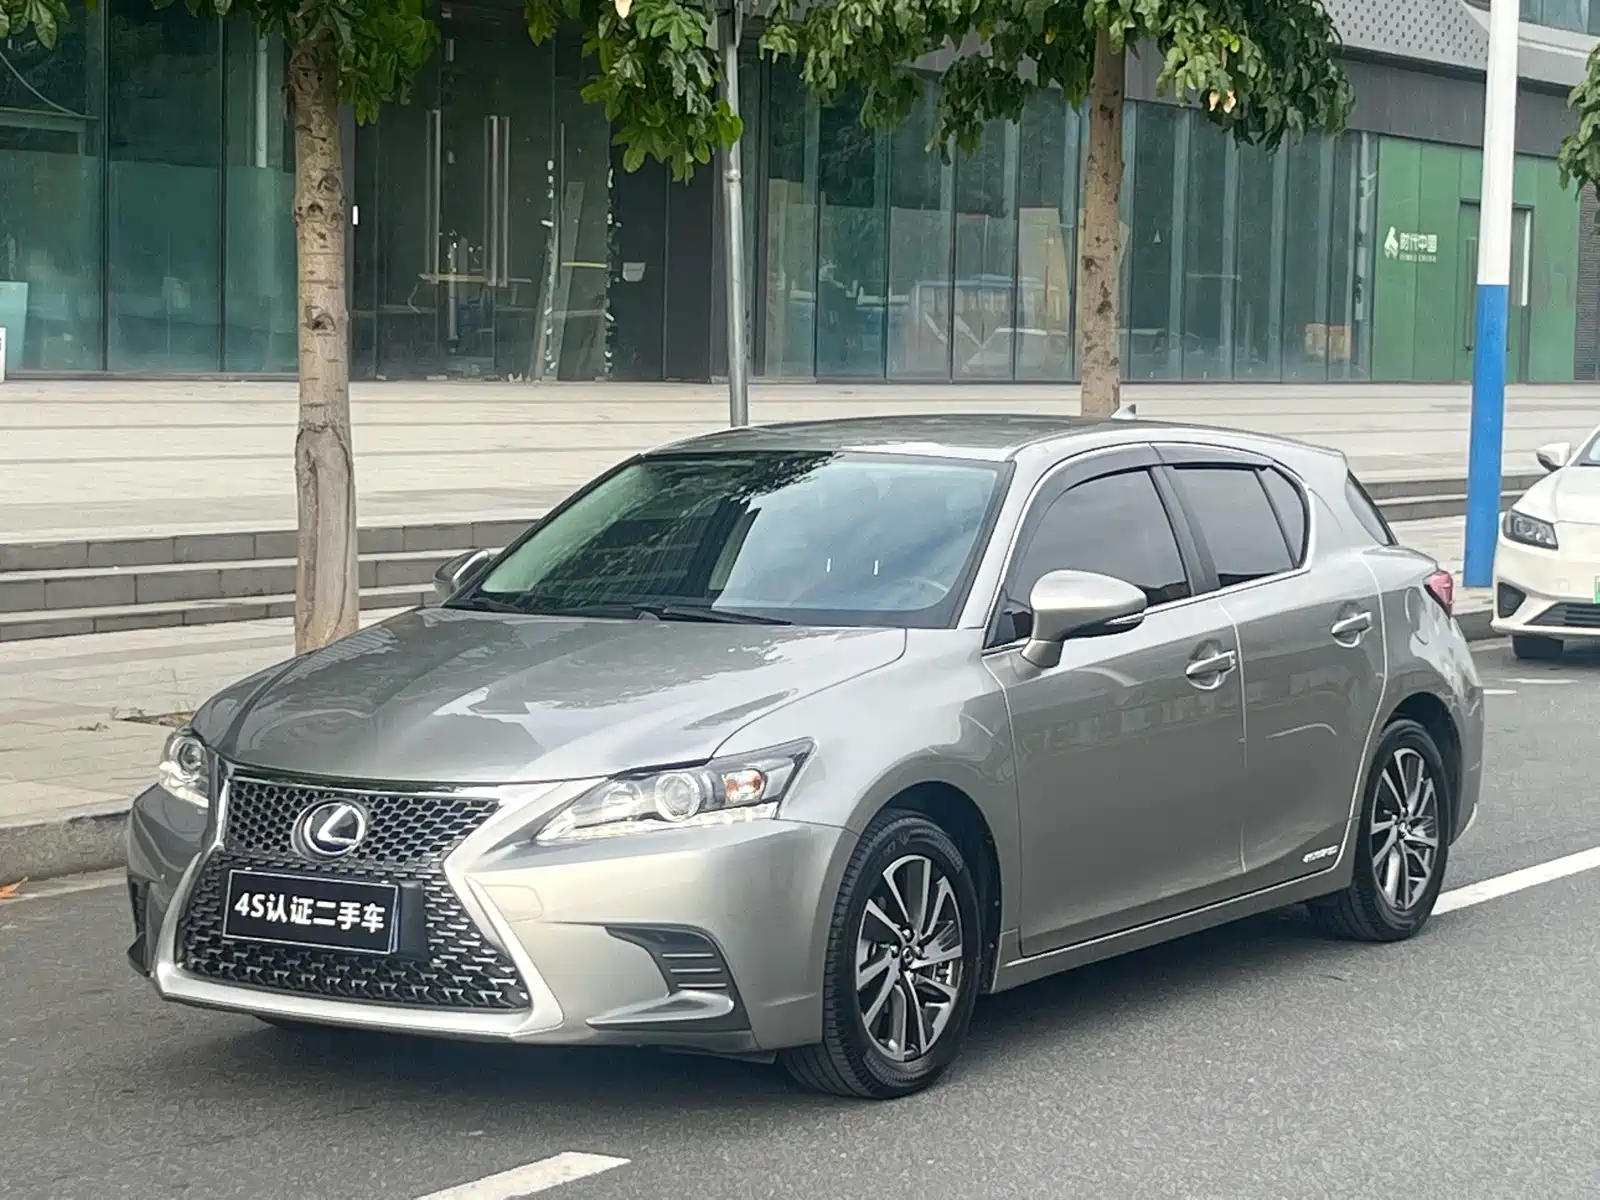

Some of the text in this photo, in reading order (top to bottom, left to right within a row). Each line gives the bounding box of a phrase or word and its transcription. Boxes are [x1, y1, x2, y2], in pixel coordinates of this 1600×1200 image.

[234, 892, 386, 933] 4S认证二手车
